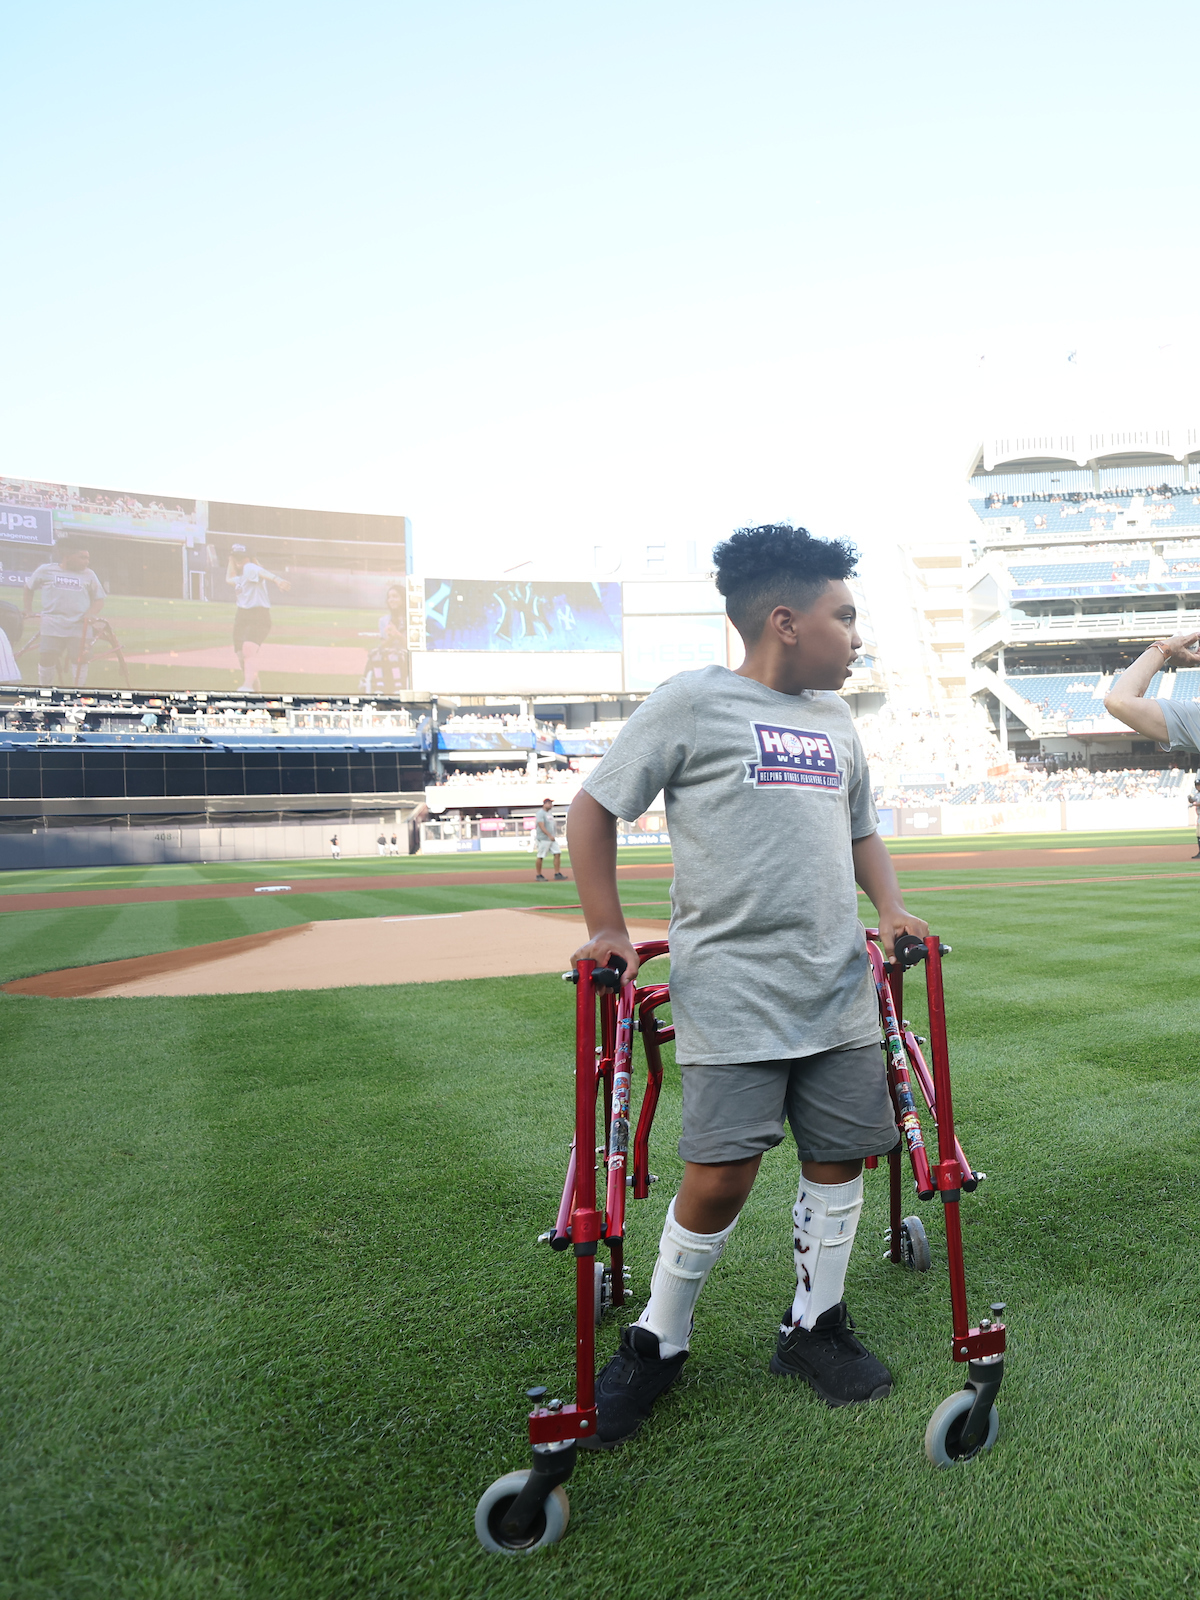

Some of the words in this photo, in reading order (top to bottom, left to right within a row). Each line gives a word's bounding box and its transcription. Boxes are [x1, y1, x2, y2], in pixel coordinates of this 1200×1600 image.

[0, 532, 38, 541] nagement
[760, 730, 833, 759] HOPE
[777, 755, 825, 767] WEEK
[760, 771, 782, 782] HELPING
